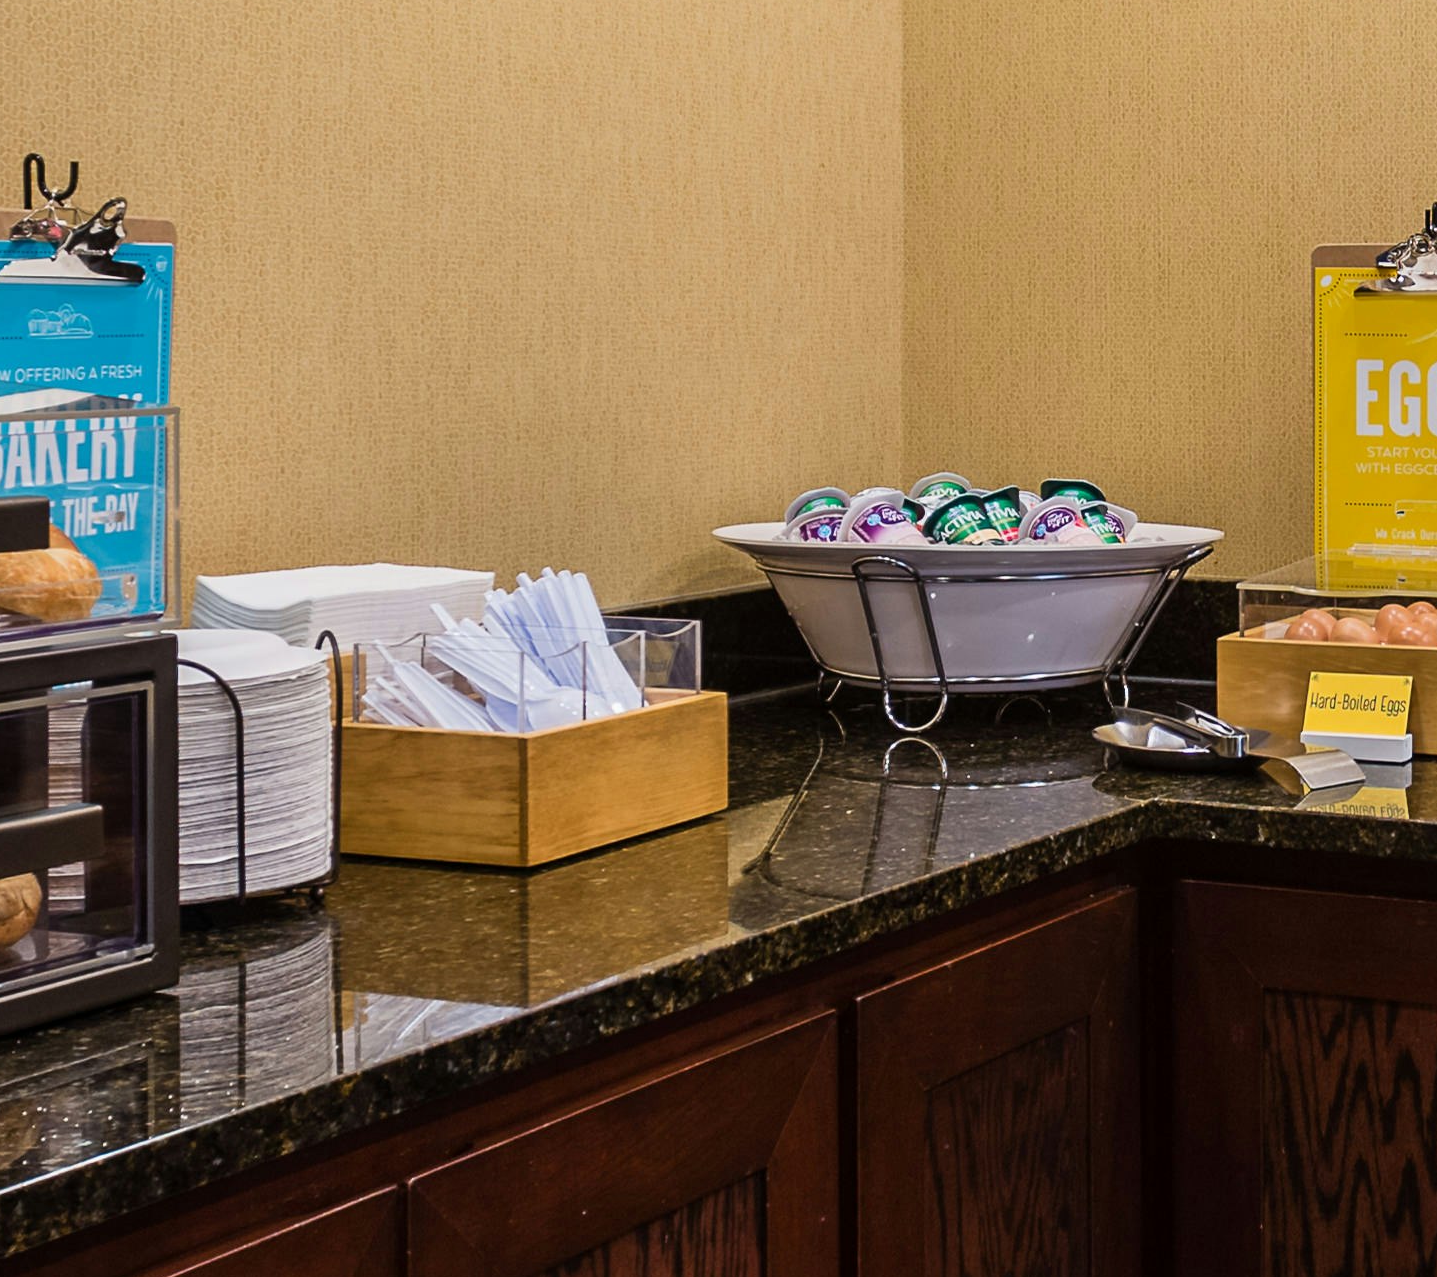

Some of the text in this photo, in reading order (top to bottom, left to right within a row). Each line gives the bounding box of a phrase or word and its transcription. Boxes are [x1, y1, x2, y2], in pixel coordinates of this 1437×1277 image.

[15, 366, 85, 383] OFFERING
[88, 367, 98, 380] A
[101, 364, 142, 379] FRESH
[1367, 446, 1410, 459] START
[1356, 462, 1391, 475] WITH
[62, 496, 98, 538] THE
[104, 492, 139, 534] DAY
[1392, 527, 1416, 540] Crack
[1310, 692, 1407, 716] Hard-Boiled Eggs
